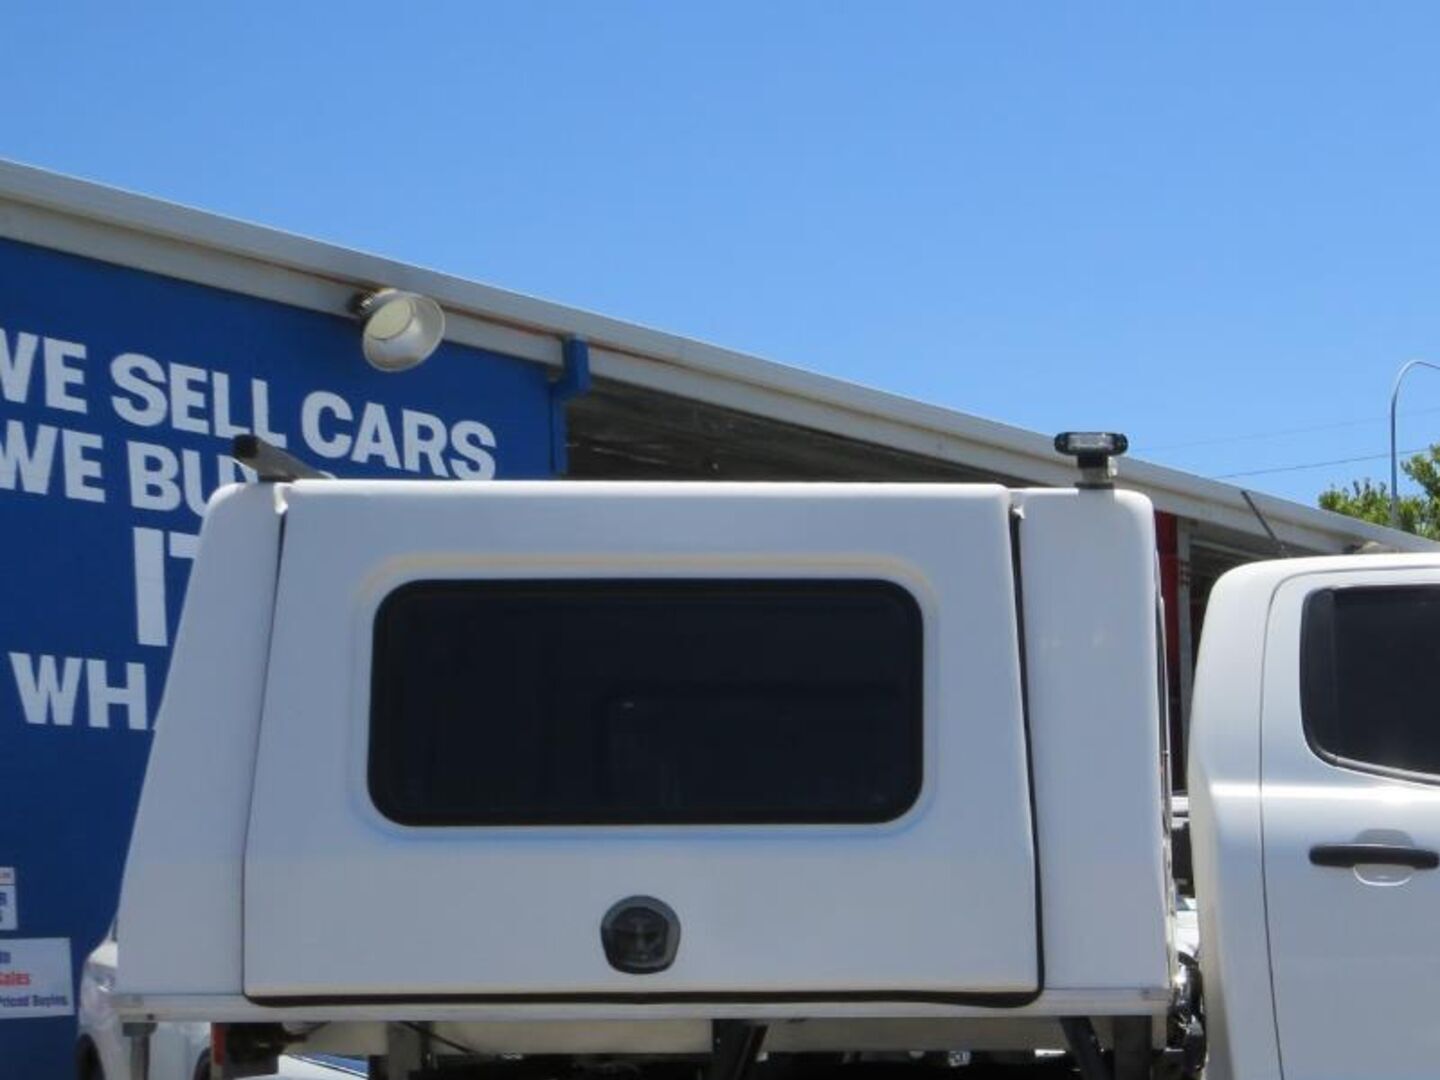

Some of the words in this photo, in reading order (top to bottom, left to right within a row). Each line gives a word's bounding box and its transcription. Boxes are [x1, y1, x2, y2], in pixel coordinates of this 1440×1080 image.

[0, 419, 105, 503] WE
[127, 440, 258, 518] BU
[110, 352, 287, 448] SELL
[302, 390, 496, 480] CARS
